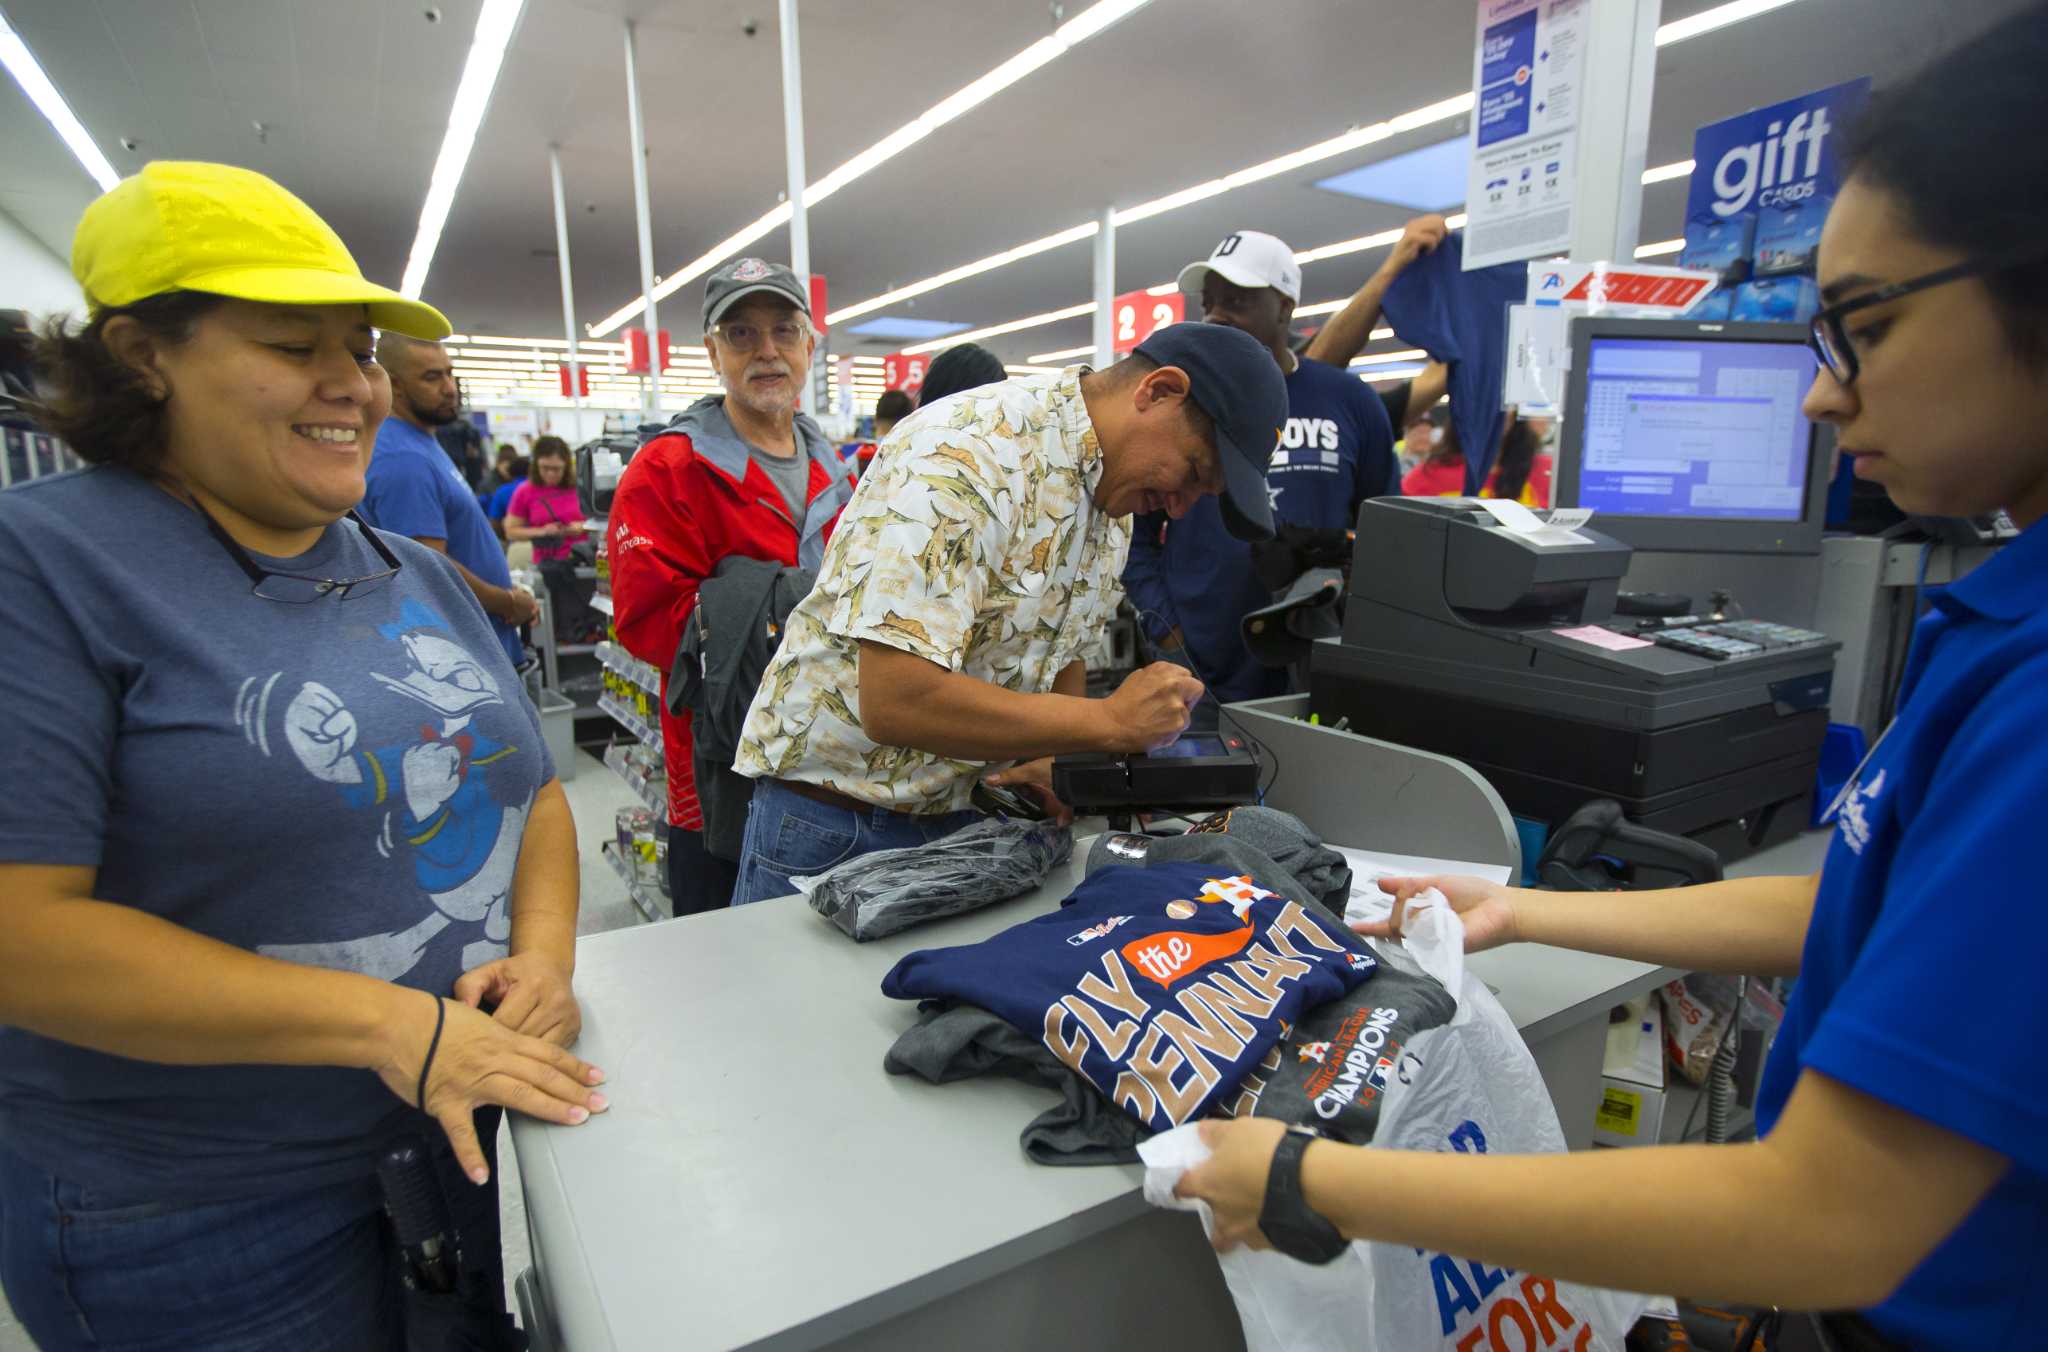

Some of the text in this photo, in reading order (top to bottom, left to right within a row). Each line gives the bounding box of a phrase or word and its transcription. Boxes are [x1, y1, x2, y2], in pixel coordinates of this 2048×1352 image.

[1711, 107, 1831, 216] gift
[1758, 180, 1816, 208] CARDS
[1118, 304, 1136, 341] 2
[1152, 303, 1174, 332] 2
[908, 360, 924, 385] 5
[1044, 948, 1151, 1095] FLY
[1137, 935, 1193, 981] the
[1313, 1007, 1399, 1120] CHAMPIONS
[1429, 1253, 1515, 1337] AL
